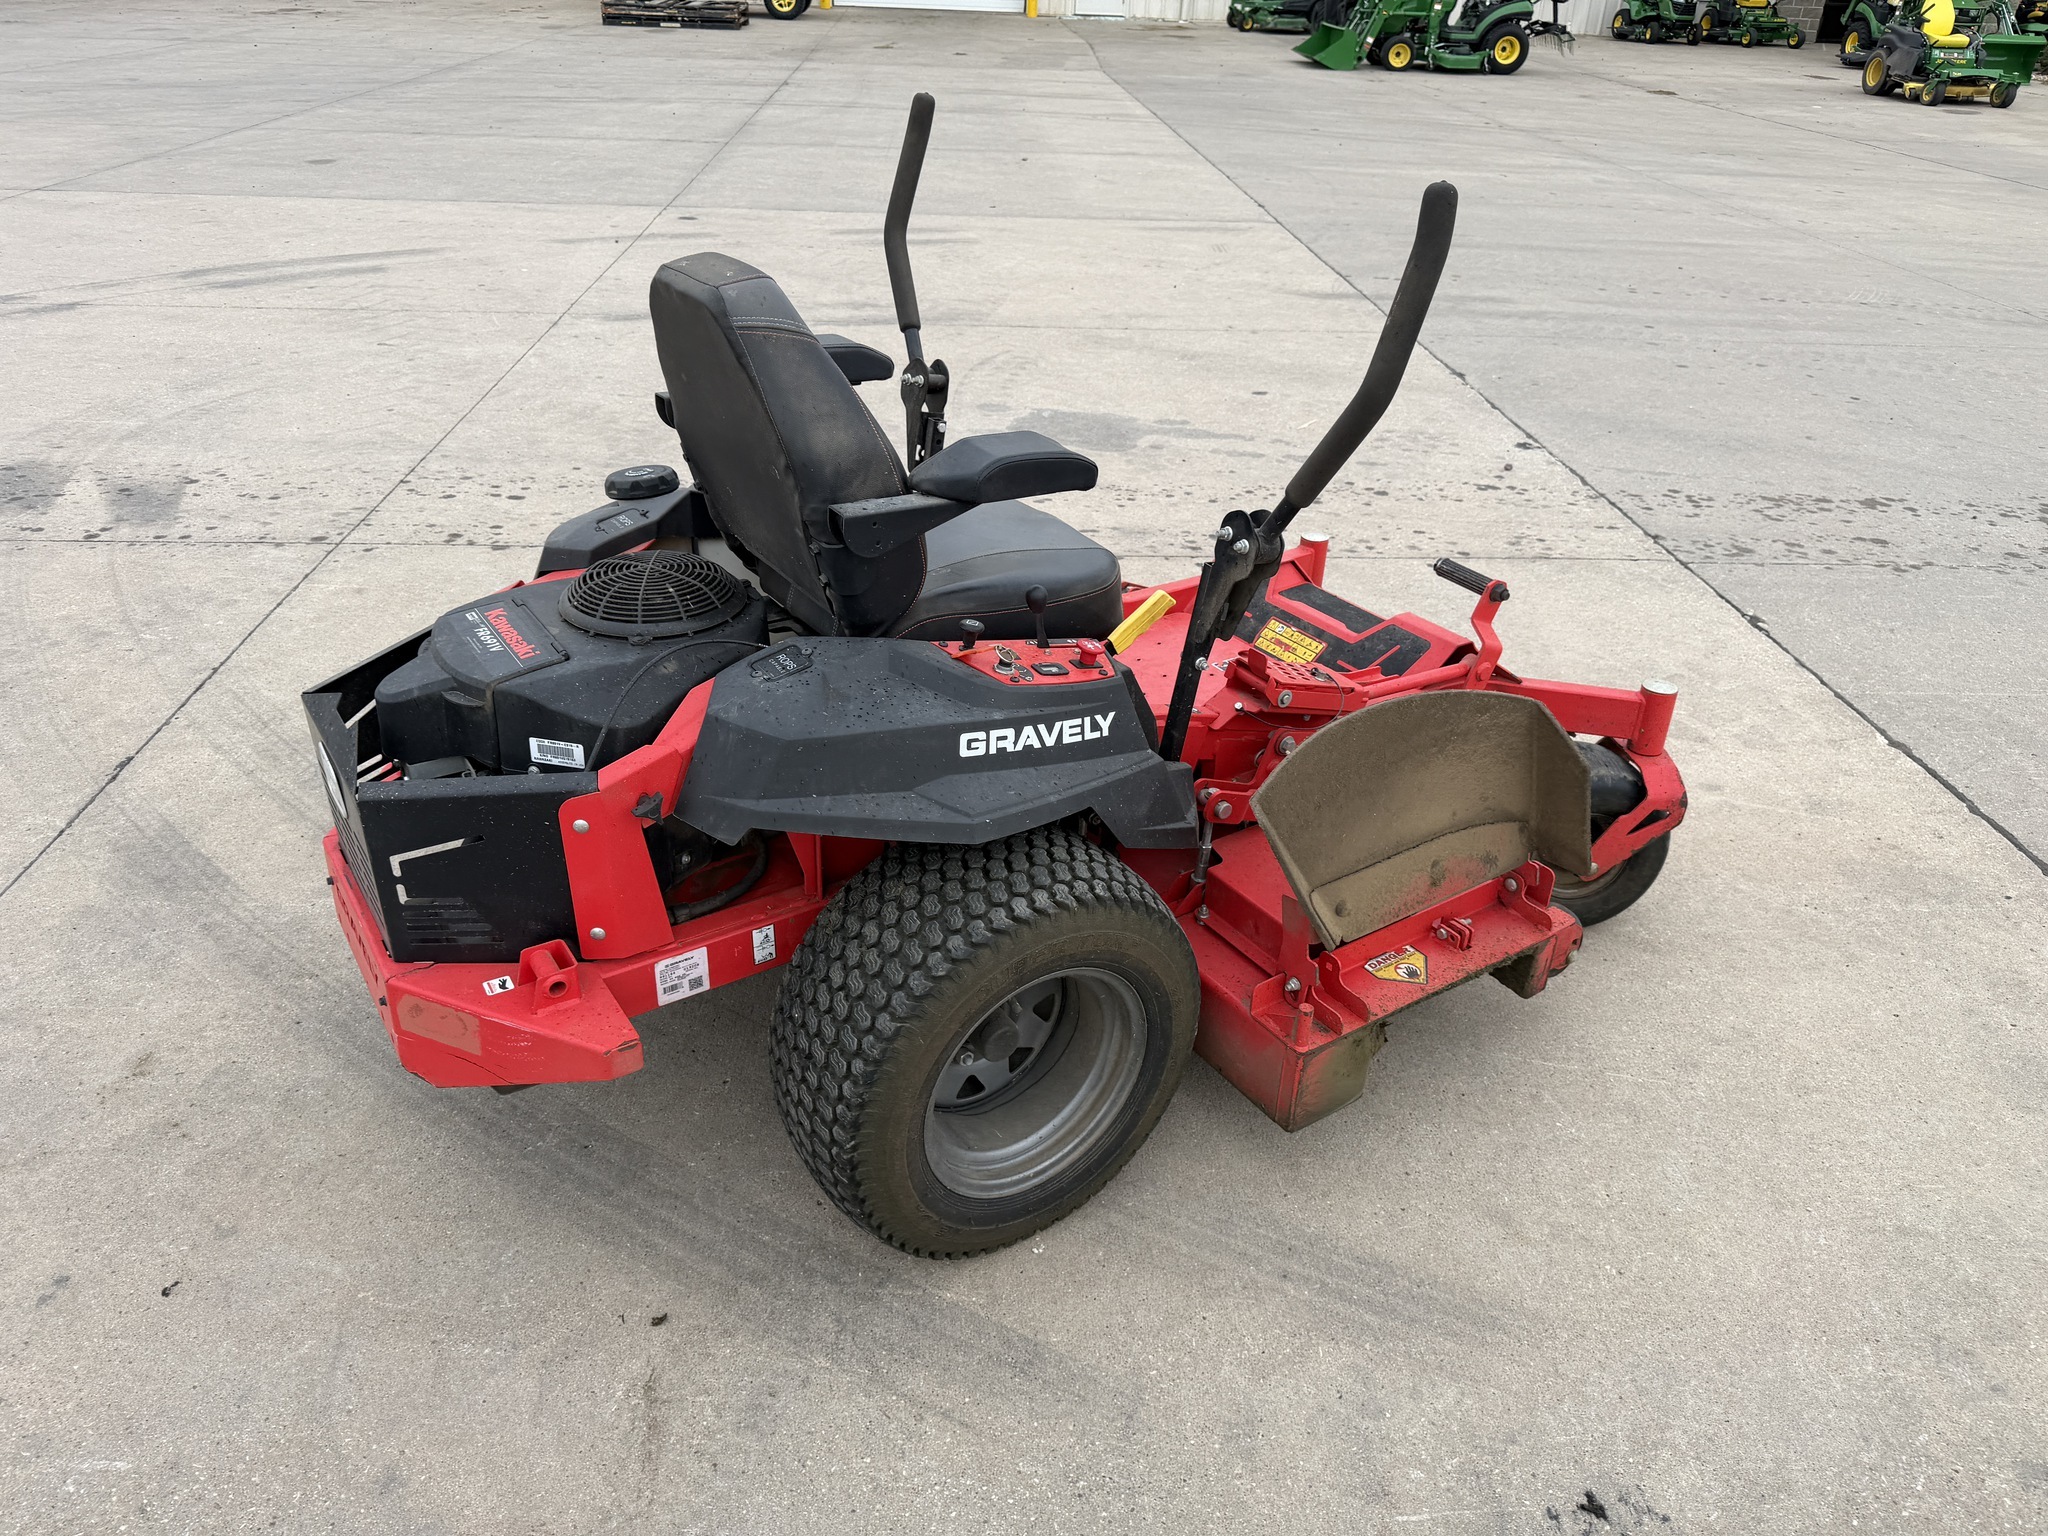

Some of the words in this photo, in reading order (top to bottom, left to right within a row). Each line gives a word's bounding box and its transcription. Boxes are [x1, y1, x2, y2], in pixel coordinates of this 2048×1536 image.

[473, 627, 505, 652] FR691V
[484, 607, 541, 660] Kawasaki
[776, 653, 797, 670] ROPS
[959, 711, 1116, 758] GRAVELY
